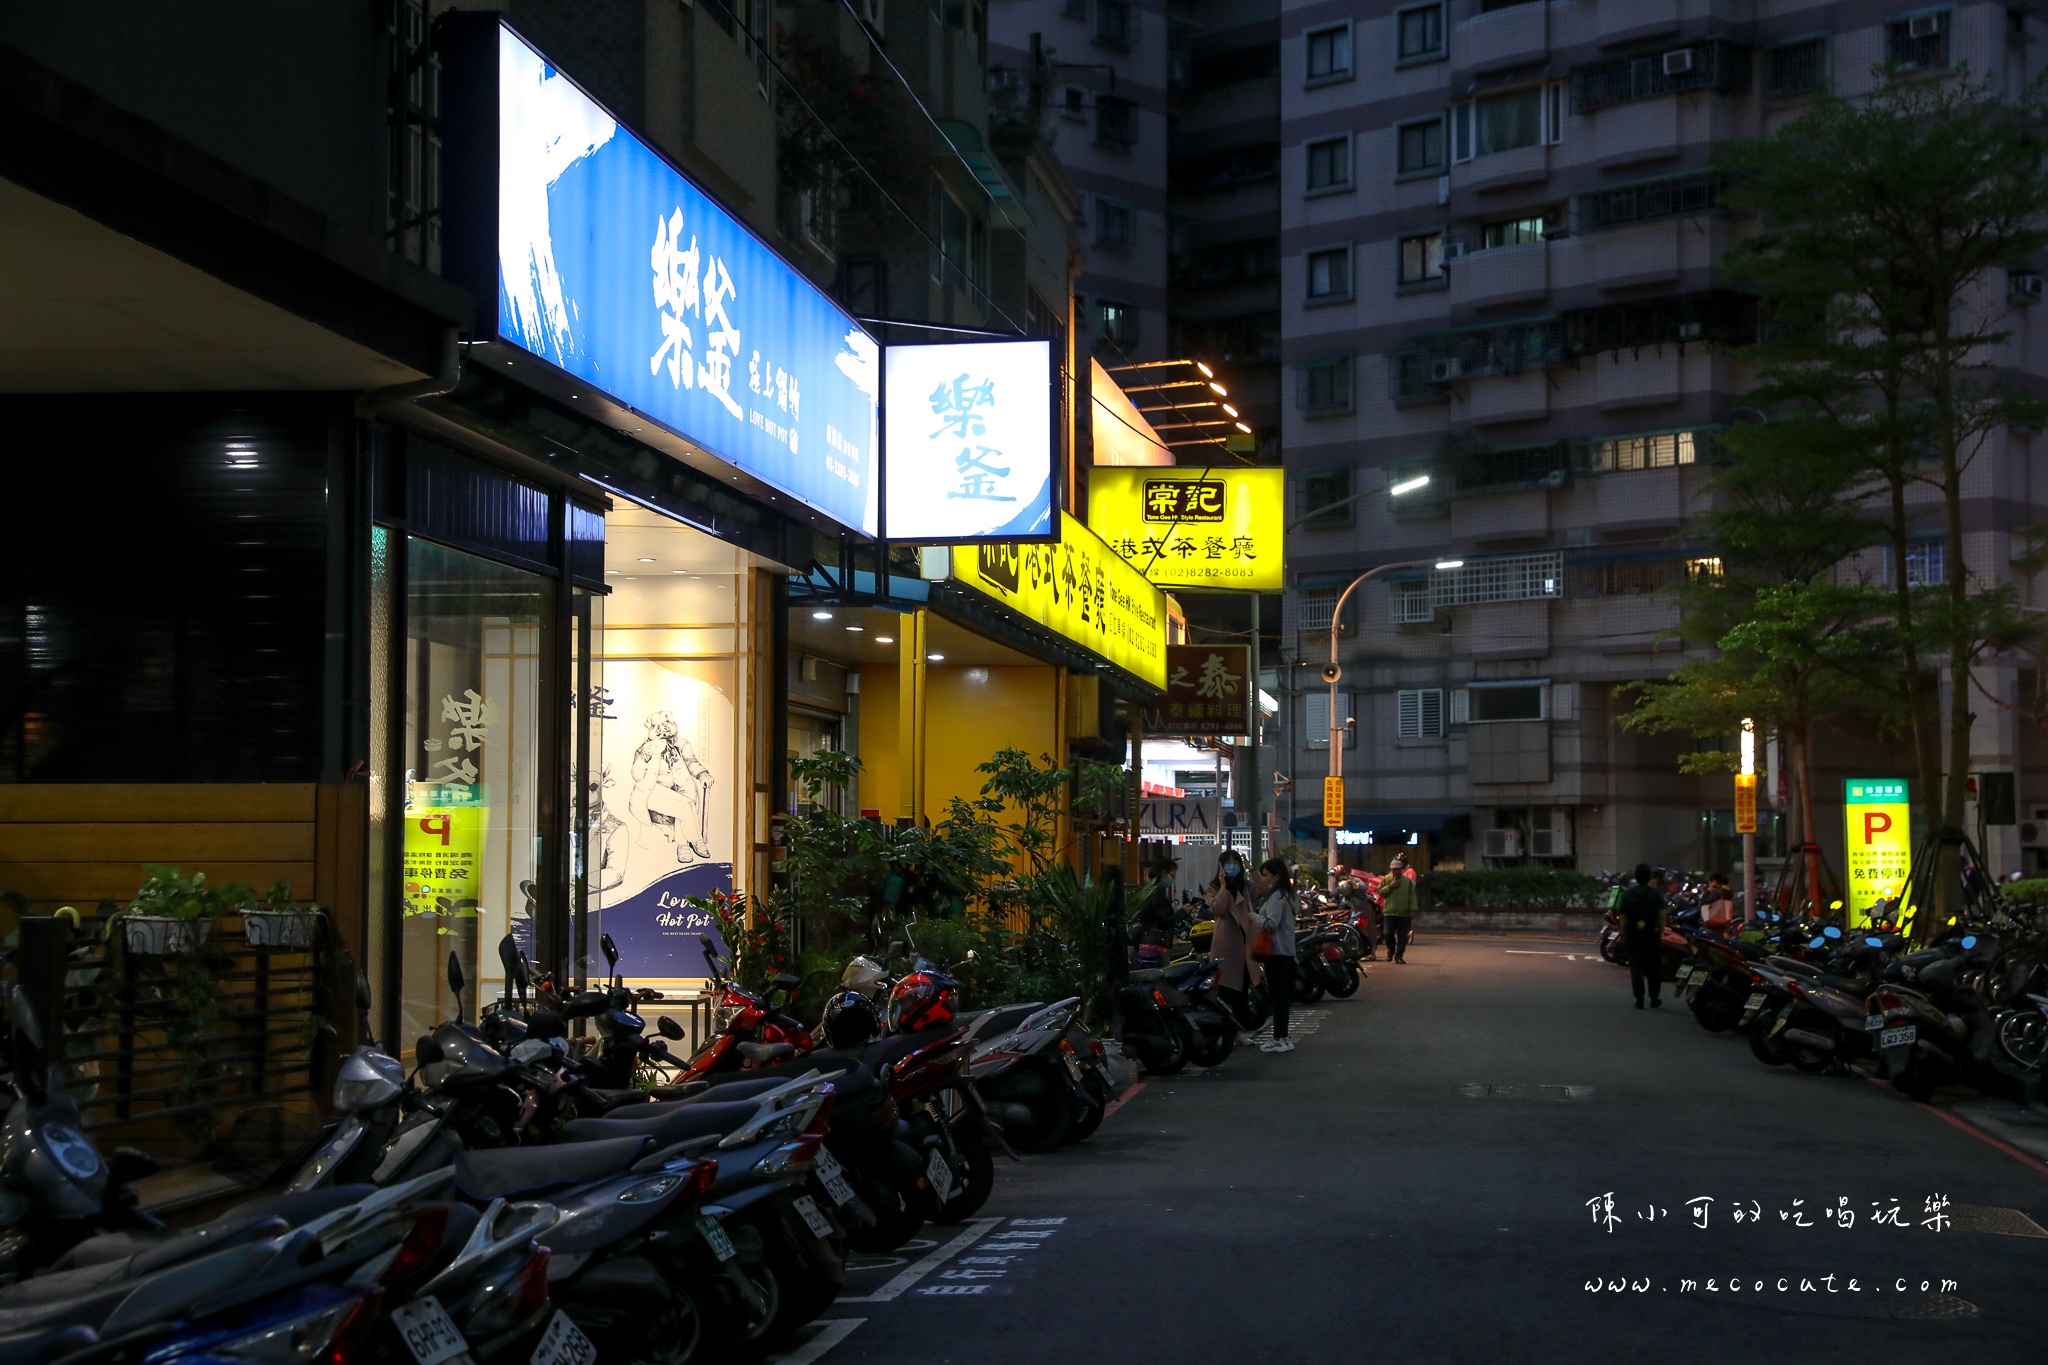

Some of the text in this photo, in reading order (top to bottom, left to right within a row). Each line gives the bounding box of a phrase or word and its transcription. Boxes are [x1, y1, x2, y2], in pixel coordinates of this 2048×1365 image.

[650, 205, 743, 421] 樂釜
[929, 373, 1017, 502] 樂釜
[1112, 535, 1257, 560] 港式茶餐廳
[1165, 568, 1254, 578] (02)8282-8083
[1169, 702, 1243, 719] 泰緬料理
[1200, 722, 1244, 731] 8281-4886
[1865, 812, 1892, 845] P
[1854, 868, 1906, 880] 免費停車
[656, 890, 697, 909] Lov
[656, 911, 710, 929] Hot Pot
